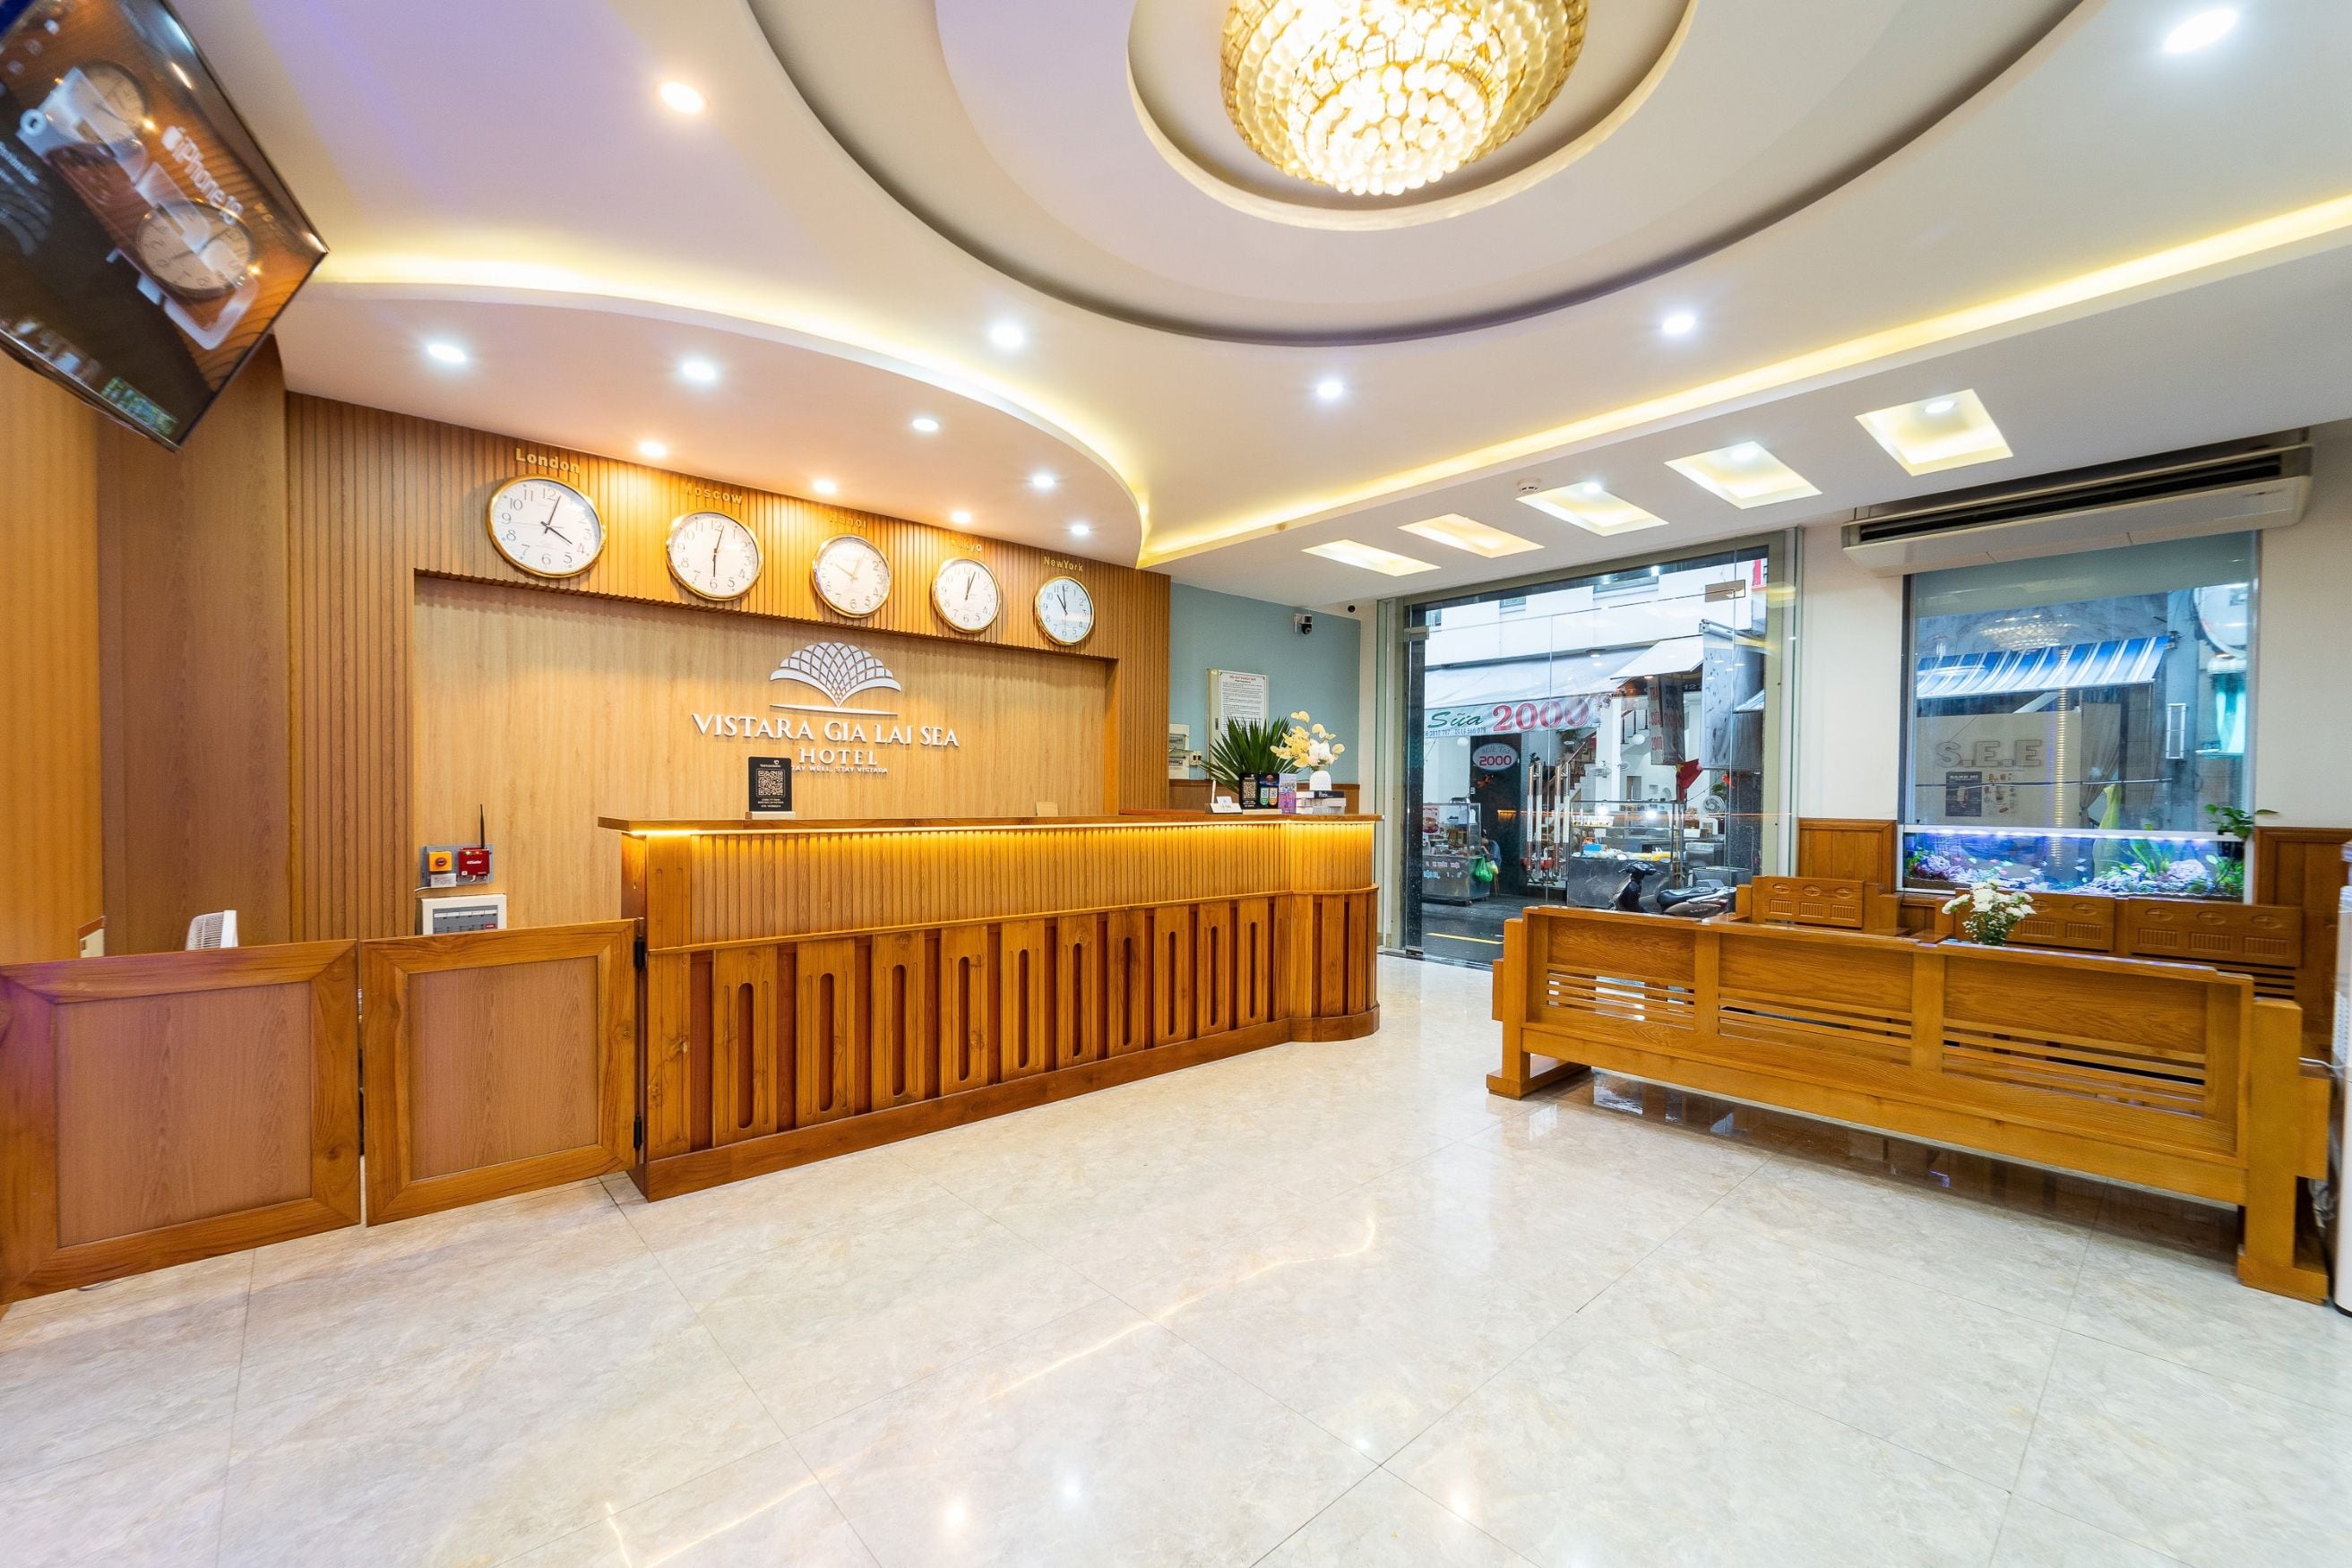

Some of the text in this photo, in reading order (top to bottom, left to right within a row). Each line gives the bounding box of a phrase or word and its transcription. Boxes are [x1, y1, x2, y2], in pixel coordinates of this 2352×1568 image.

[515, 447, 581, 474] London
[524, 489, 534, 502] 11
[542, 487, 556, 502] 12
[510, 497, 523, 511] 10
[501, 513, 512, 524] 9
[695, 521, 703, 532] 11
[711, 519, 722, 532] 12
[506, 530, 517, 542] 8
[583, 529, 592, 540] 3
[685, 529, 695, 540] 10
[521, 543, 530, 556] 7
[576, 542, 585, 554] 4
[677, 543, 685, 553] 9
[741, 540, 748, 552] 2
[541, 554, 552, 565] 6
[563, 552, 573, 564] 5
[681, 556, 690, 568] 8
[744, 556, 751, 567] 3
[1044, 556, 1083, 572] NewYork
[873, 560, 879, 571] 2
[694, 570, 701, 581] 7
[738, 568, 745, 579] 4
[876, 574, 883, 584] 3
[710, 578, 718, 590] 6
[727, 576, 736, 588] 5
[873, 587, 879, 597] 4
[849, 599, 857, 609] 6
[864, 596, 871, 607] 5
[1426, 711, 1485, 728] Sữa
[1492, 700, 1590, 732] 2000
[691, 713, 960, 747] VISTARA GIA LAI SEA
[798, 747, 878, 765] HOTEL
[1478, 754, 1512, 766] 2000
